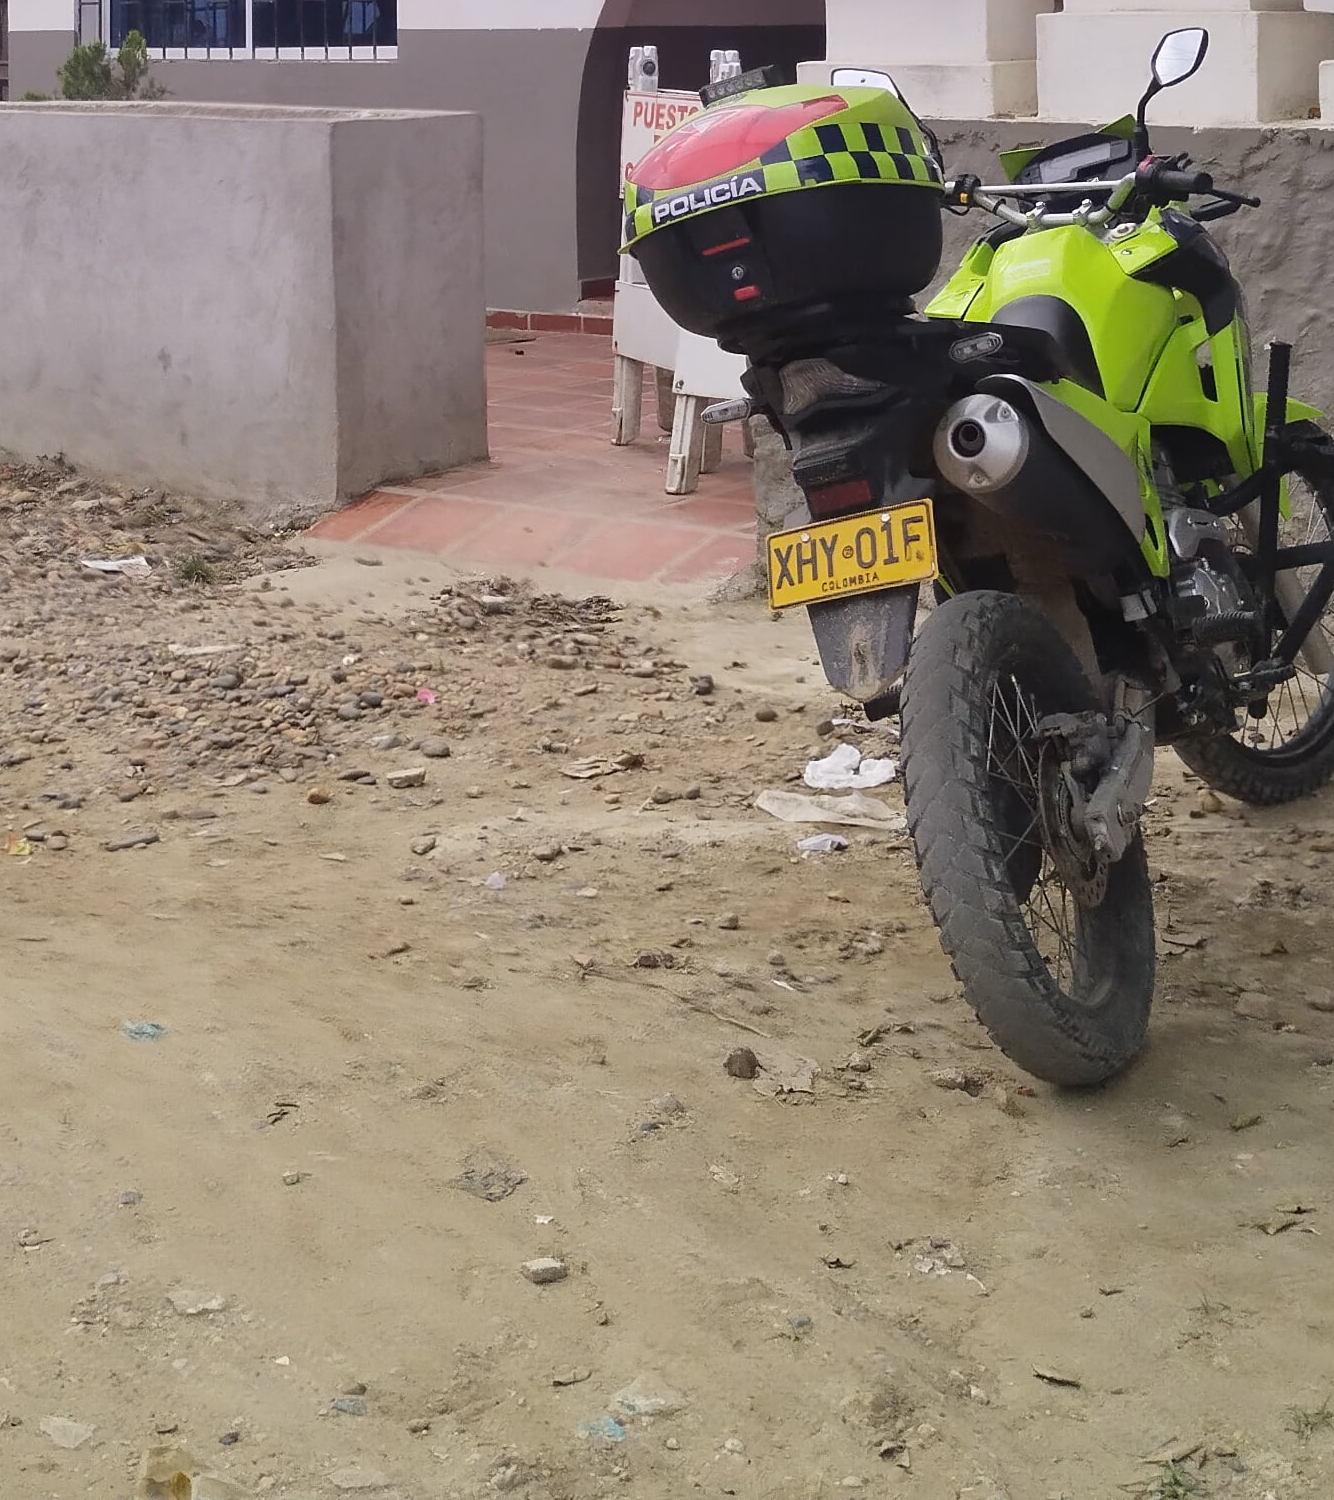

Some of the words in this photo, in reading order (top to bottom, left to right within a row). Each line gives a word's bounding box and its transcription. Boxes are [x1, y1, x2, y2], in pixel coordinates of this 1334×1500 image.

[654, 176, 763, 223] POLICÍA
[774, 534, 838, 589] XHY
[822, 571, 880, 592] COLOMBIA
